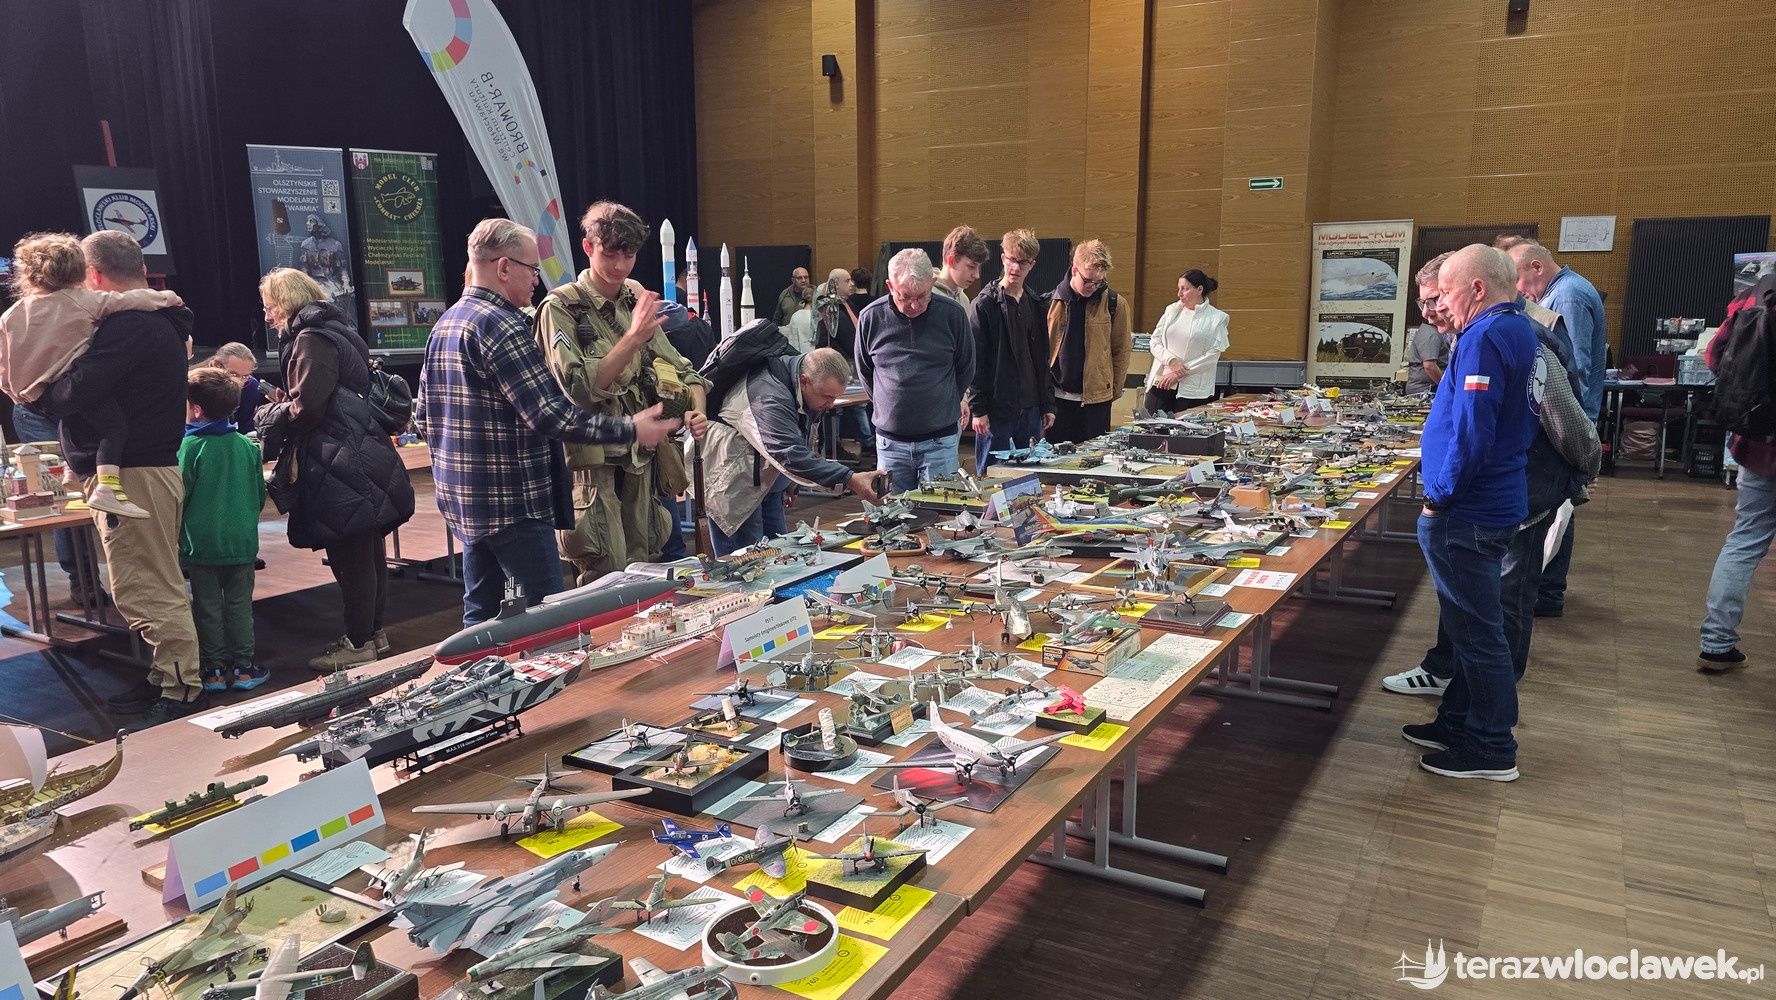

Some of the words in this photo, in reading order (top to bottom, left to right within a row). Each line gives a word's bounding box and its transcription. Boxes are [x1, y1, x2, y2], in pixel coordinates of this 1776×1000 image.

[272, 178, 318, 188] OLSZTYŃSKIE
[375, 173, 398, 191] MODEL
[402, 174, 420, 192] CLUB
[257, 187, 319, 196] STOWARZYSZENIE
[277, 196, 319, 204] MODELARZY
[129, 196, 156, 232] MODELARSKI
